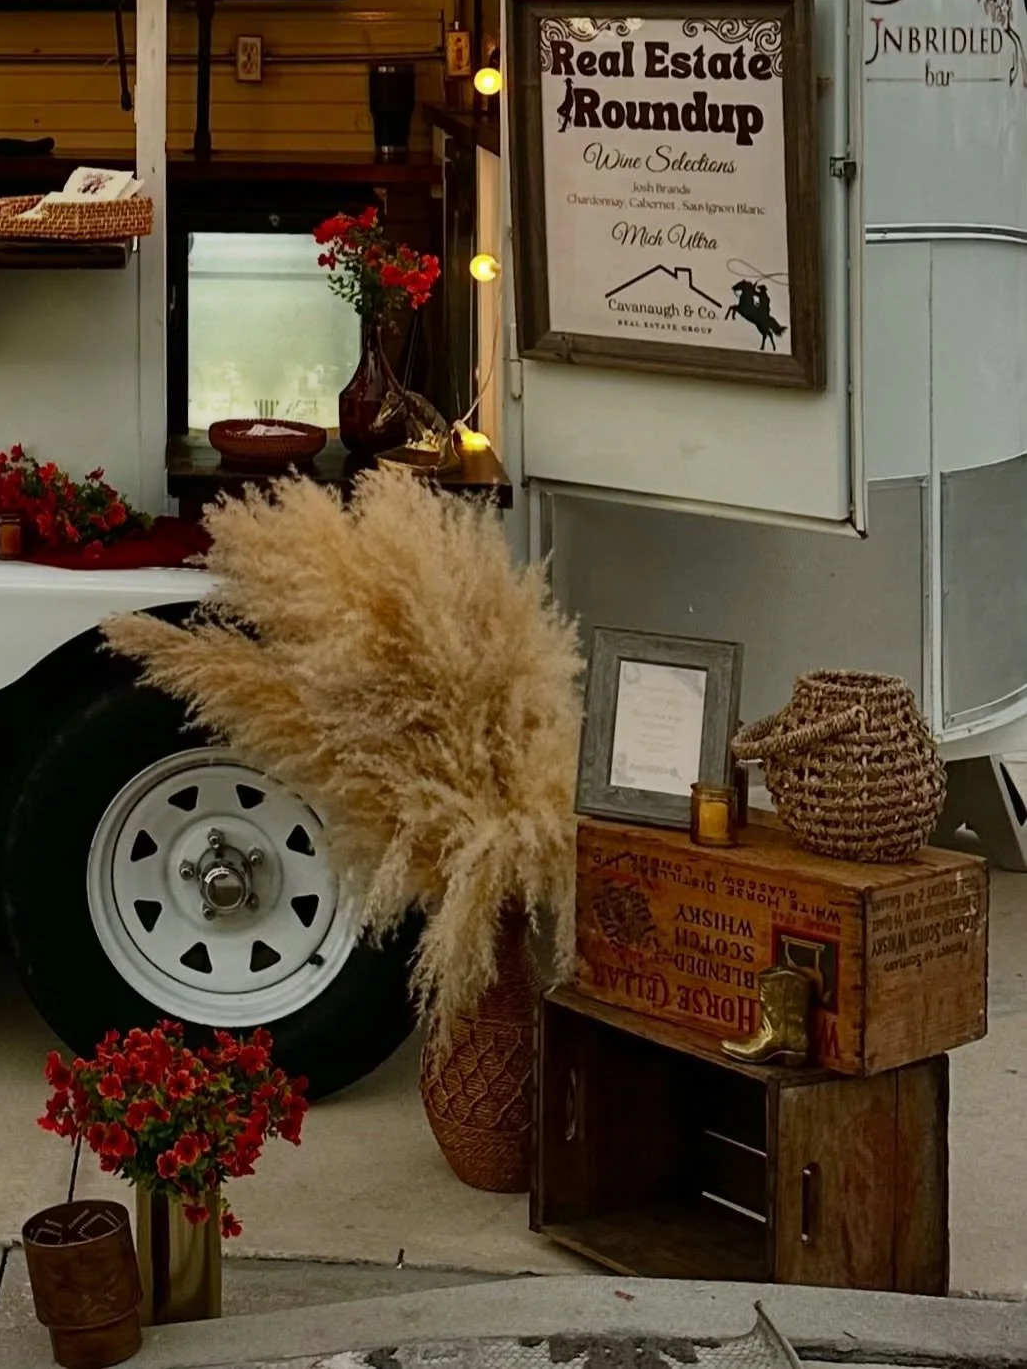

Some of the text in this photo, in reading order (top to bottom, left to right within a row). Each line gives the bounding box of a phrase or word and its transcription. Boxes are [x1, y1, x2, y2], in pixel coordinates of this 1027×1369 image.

[550, 41, 772, 80] Real Estate
[925, 60, 954, 87] bar
[573, 88, 764, 146] Roundup
[583, 142, 737, 173] Wine Selections
[631, 182, 691, 195] Josh Brands
[682, 200, 735, 215] Sauvignon
[736, 203, 766, 215] Blanc
[612, 221, 718, 250] Mich Ultra
[608, 298, 680, 319] Cavanaugh
[683, 305, 694, 318] &
[617, 319, 713, 334] REAL ESTATE GROUP
[721, 875, 797, 899] GLASGOW
[725, 885, 779, 910] HORSE
[674, 904, 754, 939] WHISKY
[790, 900, 841, 925] WHITE
[675, 926, 755, 964] SCOTCH
[674, 953, 755, 990] BLENDED
[677, 985, 759, 1034] HORSE
